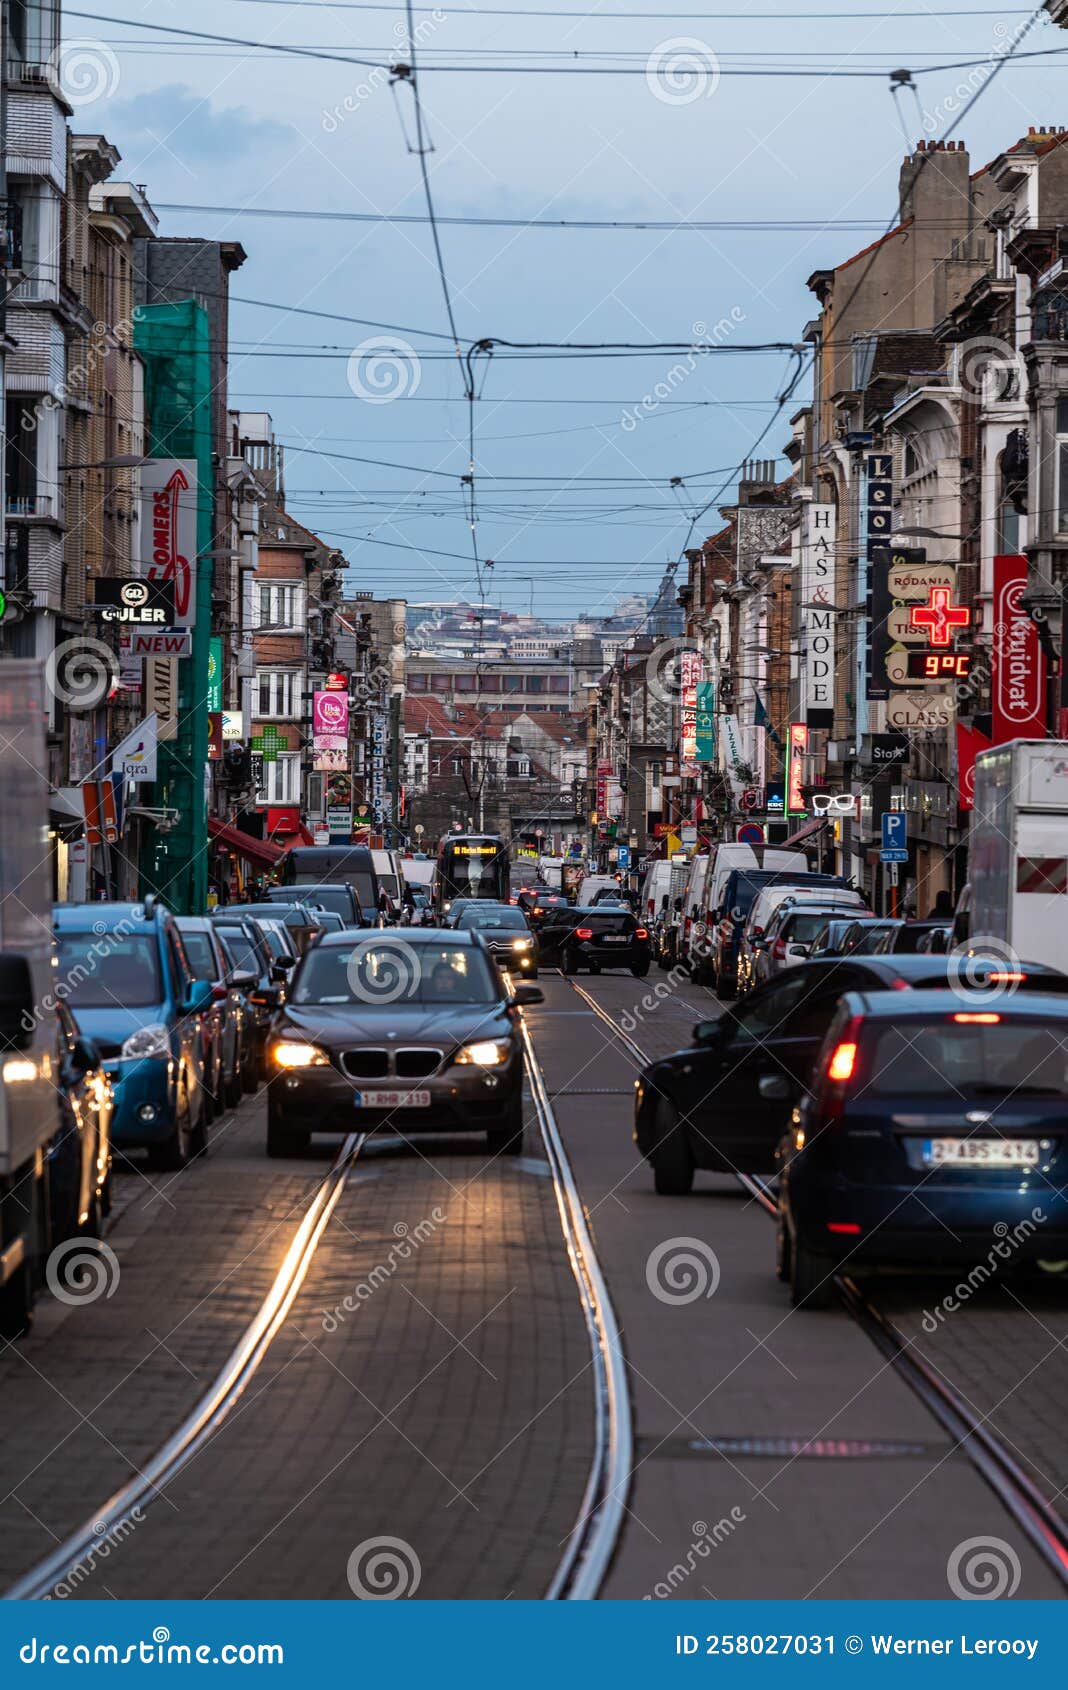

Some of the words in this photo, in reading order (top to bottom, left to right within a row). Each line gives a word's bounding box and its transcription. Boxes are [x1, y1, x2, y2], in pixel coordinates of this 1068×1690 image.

[814, 511, 830, 577] HAS
[894, 578, 951, 586] RODANIA
[812, 584, 829, 604] &
[894, 623, 930, 635] TISS
[135, 636, 186, 652] NEW
[811, 612, 830, 702] MODE
[1009, 616, 1032, 710] Kruidvat
[893, 711, 949, 725] CLAES
[725, 716, 740, 769] PIZZER
[122, 762, 148, 777] Iqra
[888, 816, 900, 834] P
[619, 848, 627, 860] P
